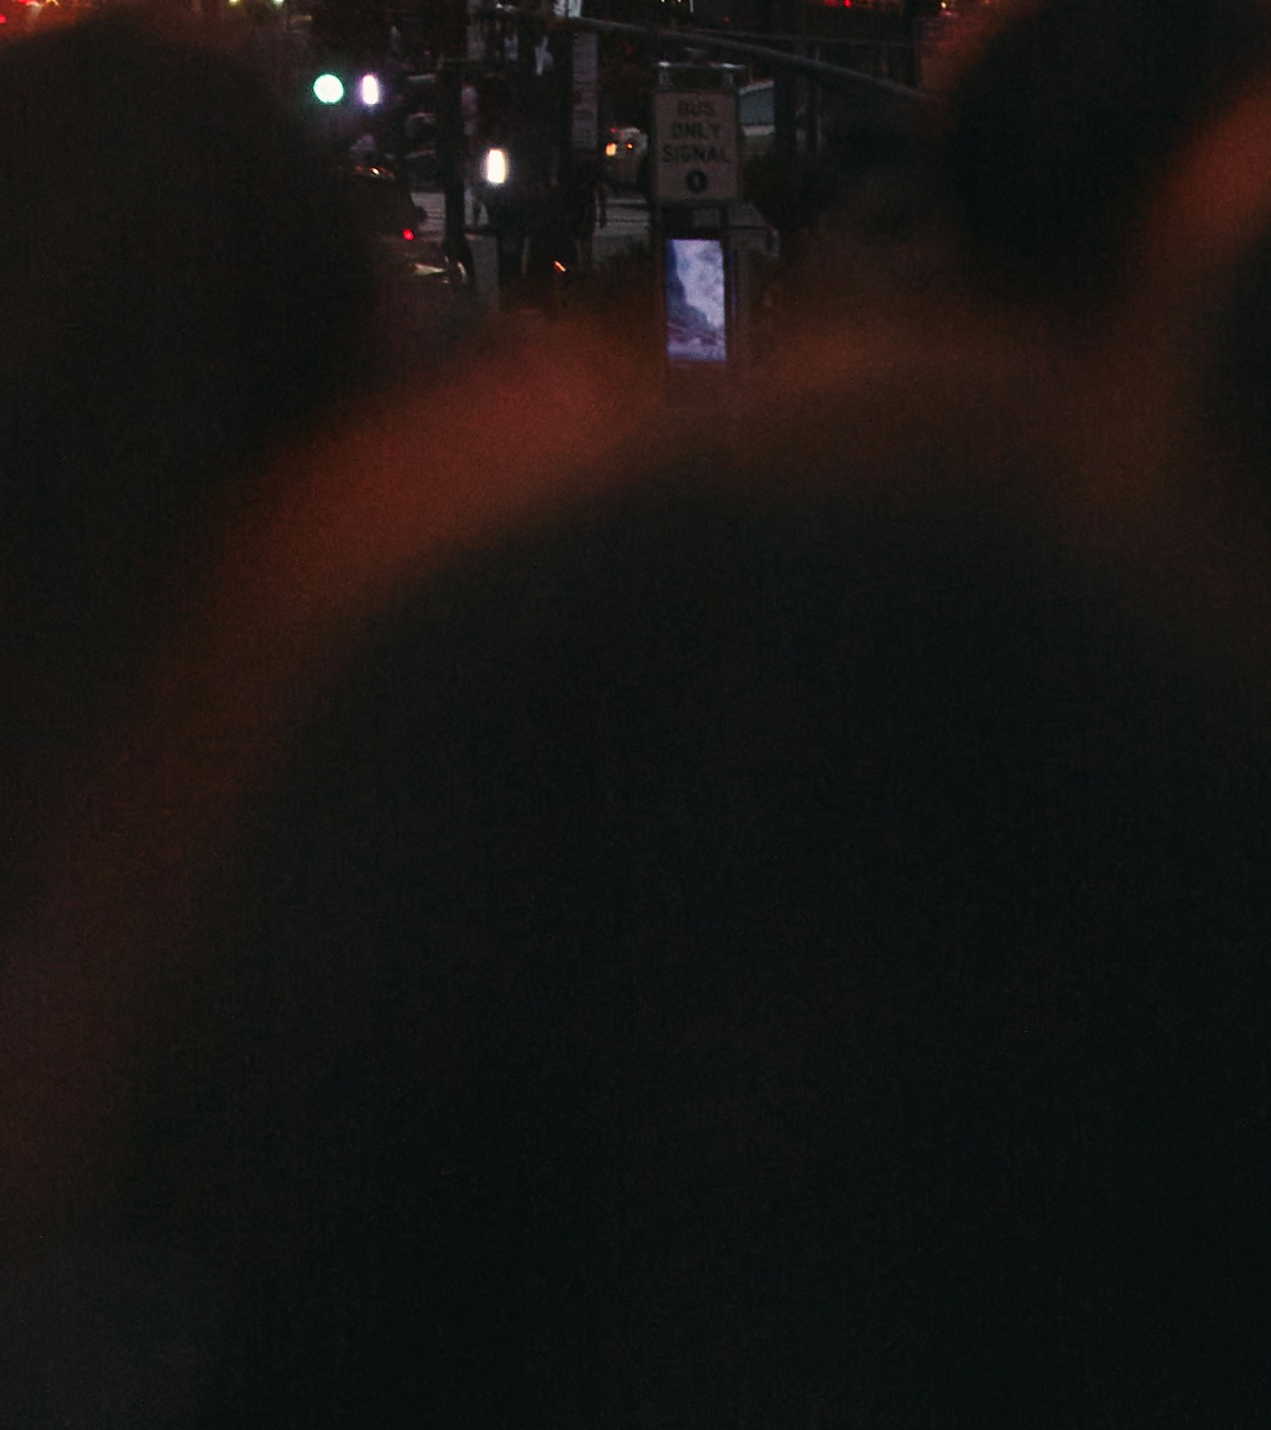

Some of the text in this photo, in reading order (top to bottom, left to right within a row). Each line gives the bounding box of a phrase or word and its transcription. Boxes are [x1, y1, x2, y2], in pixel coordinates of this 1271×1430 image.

[676, 99, 715, 117] BUS
[670, 121, 722, 139] ONLY
[661, 145, 730, 163] SIGNAL
